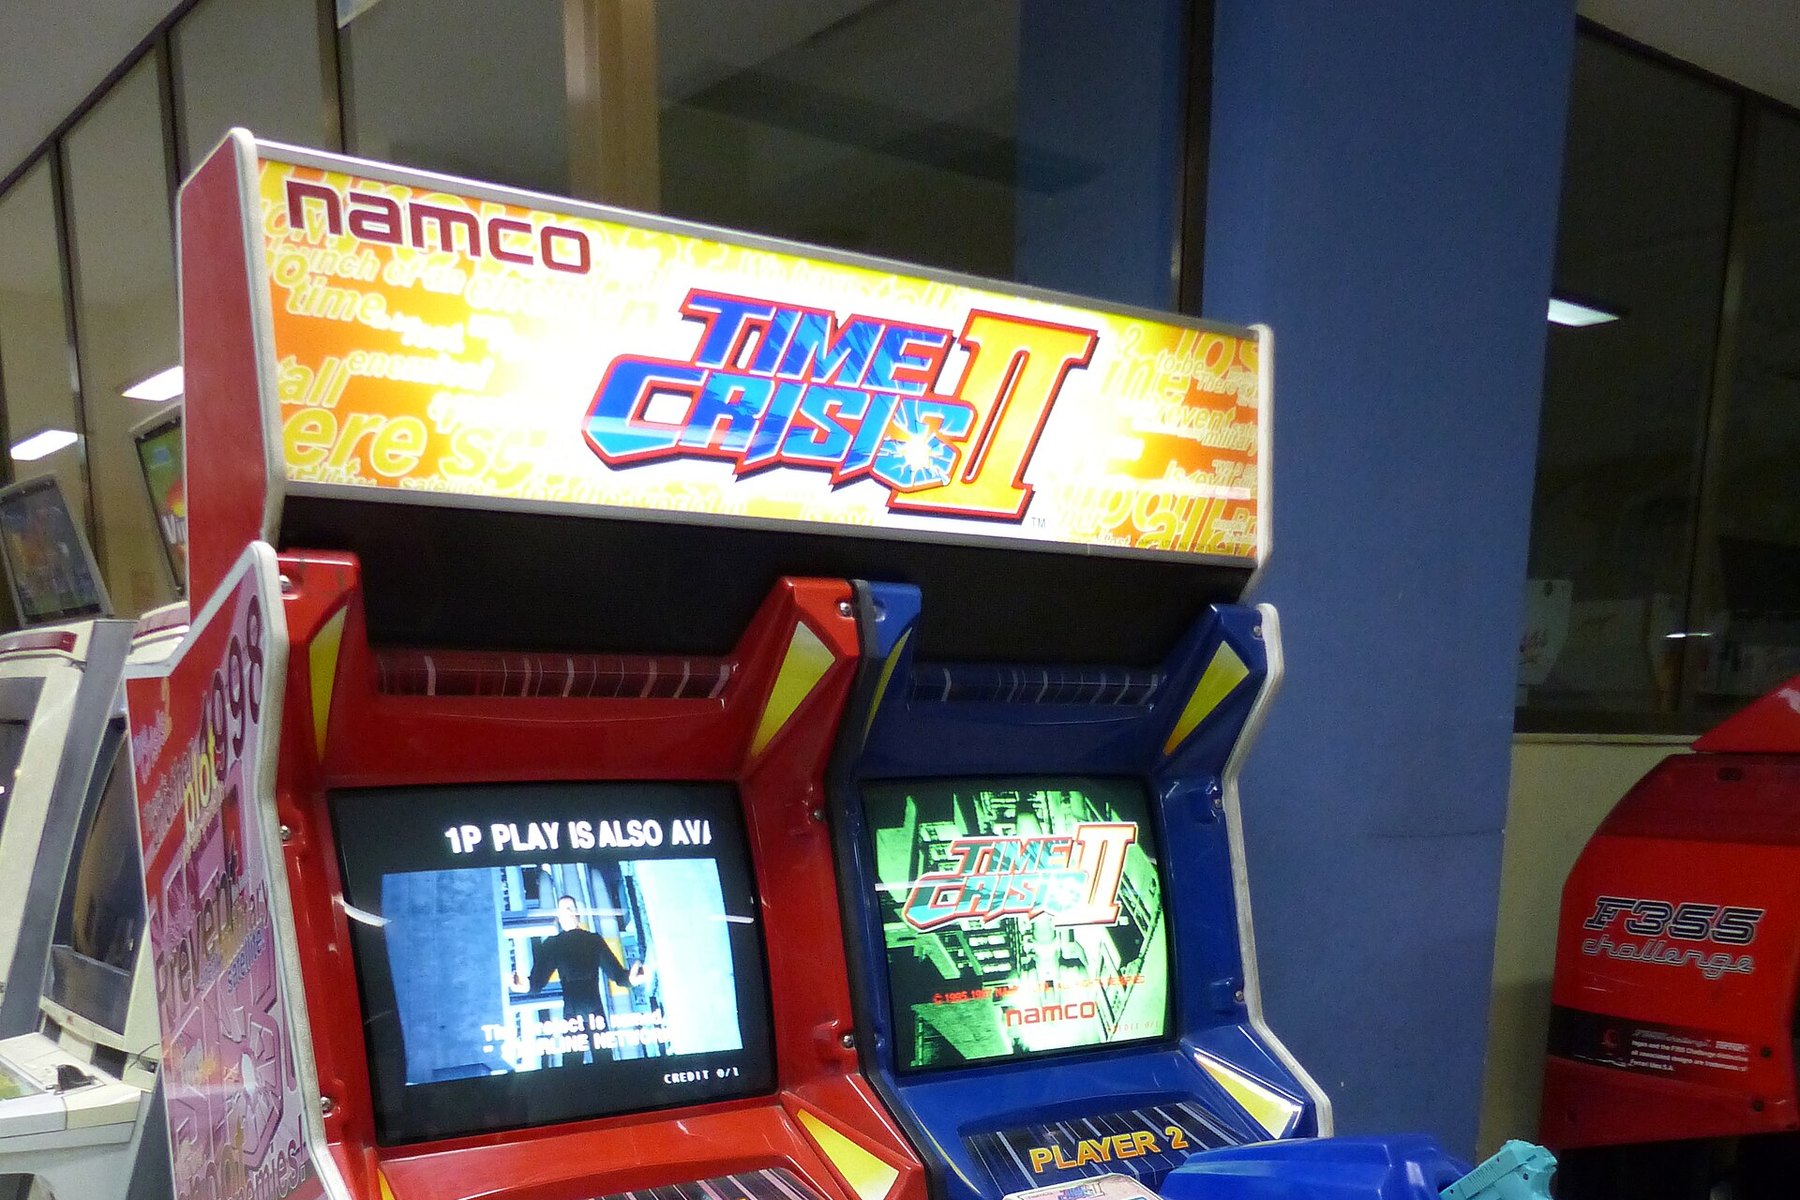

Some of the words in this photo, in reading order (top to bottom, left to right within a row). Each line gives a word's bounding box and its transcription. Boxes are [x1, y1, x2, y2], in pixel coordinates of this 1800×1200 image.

[286, 180, 591, 275] namco
[678, 288, 957, 398] TIME
[582, 354, 978, 492] CRISIS
[1031, 517, 1047, 530] TM
[445, 824, 482, 854] 1P
[492, 821, 560, 853] PLAY
[568, 820, 597, 850] IS
[599, 819, 664, 848] ALSO
[951, 837, 1074, 877] TIME
[1583, 895, 1766, 946] F355
[1006, 1001, 1096, 1027] namco
[664, 1069, 709, 1085] CREDIT
[1028, 1130, 1161, 1174] PLAYER
[1165, 1126, 1189, 1150] 2
